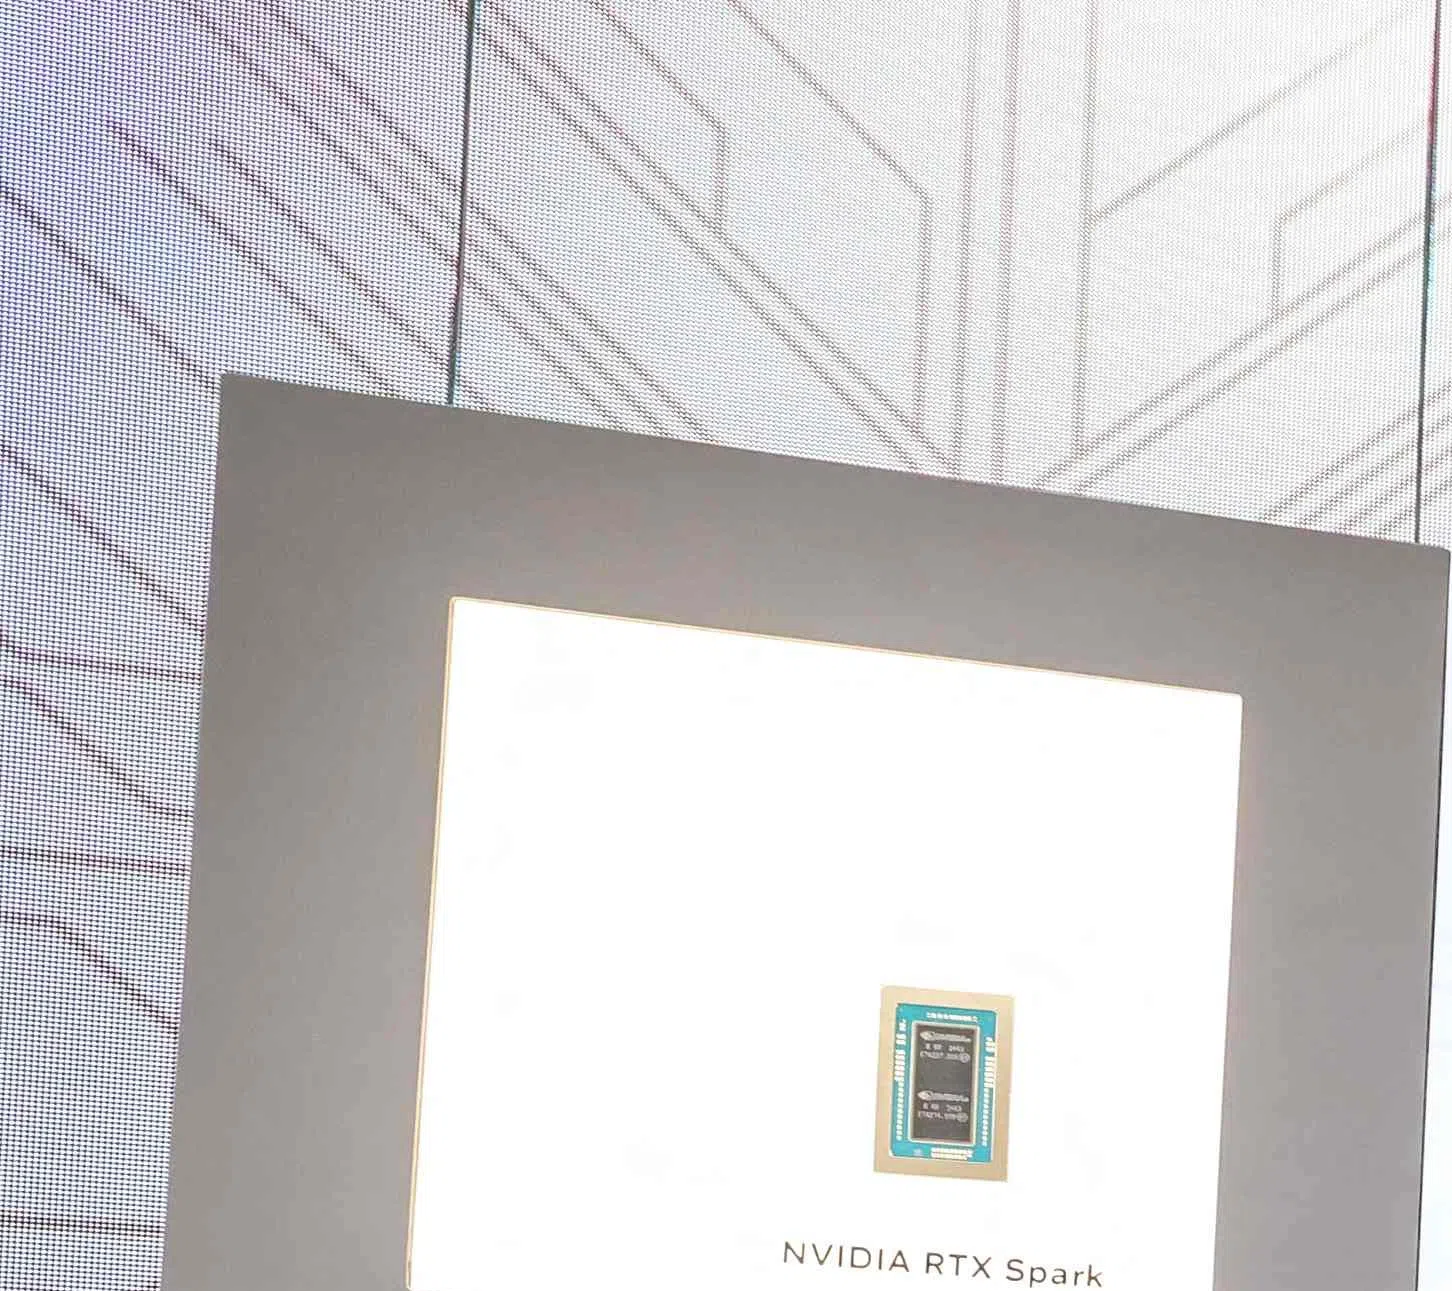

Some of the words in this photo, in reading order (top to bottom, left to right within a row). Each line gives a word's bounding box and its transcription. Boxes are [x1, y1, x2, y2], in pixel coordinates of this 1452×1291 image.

[784, 1242, 910, 1273] NVIDIA
[926, 1253, 992, 1279] RTX
[1006, 1259, 1102, 1289] Spark
